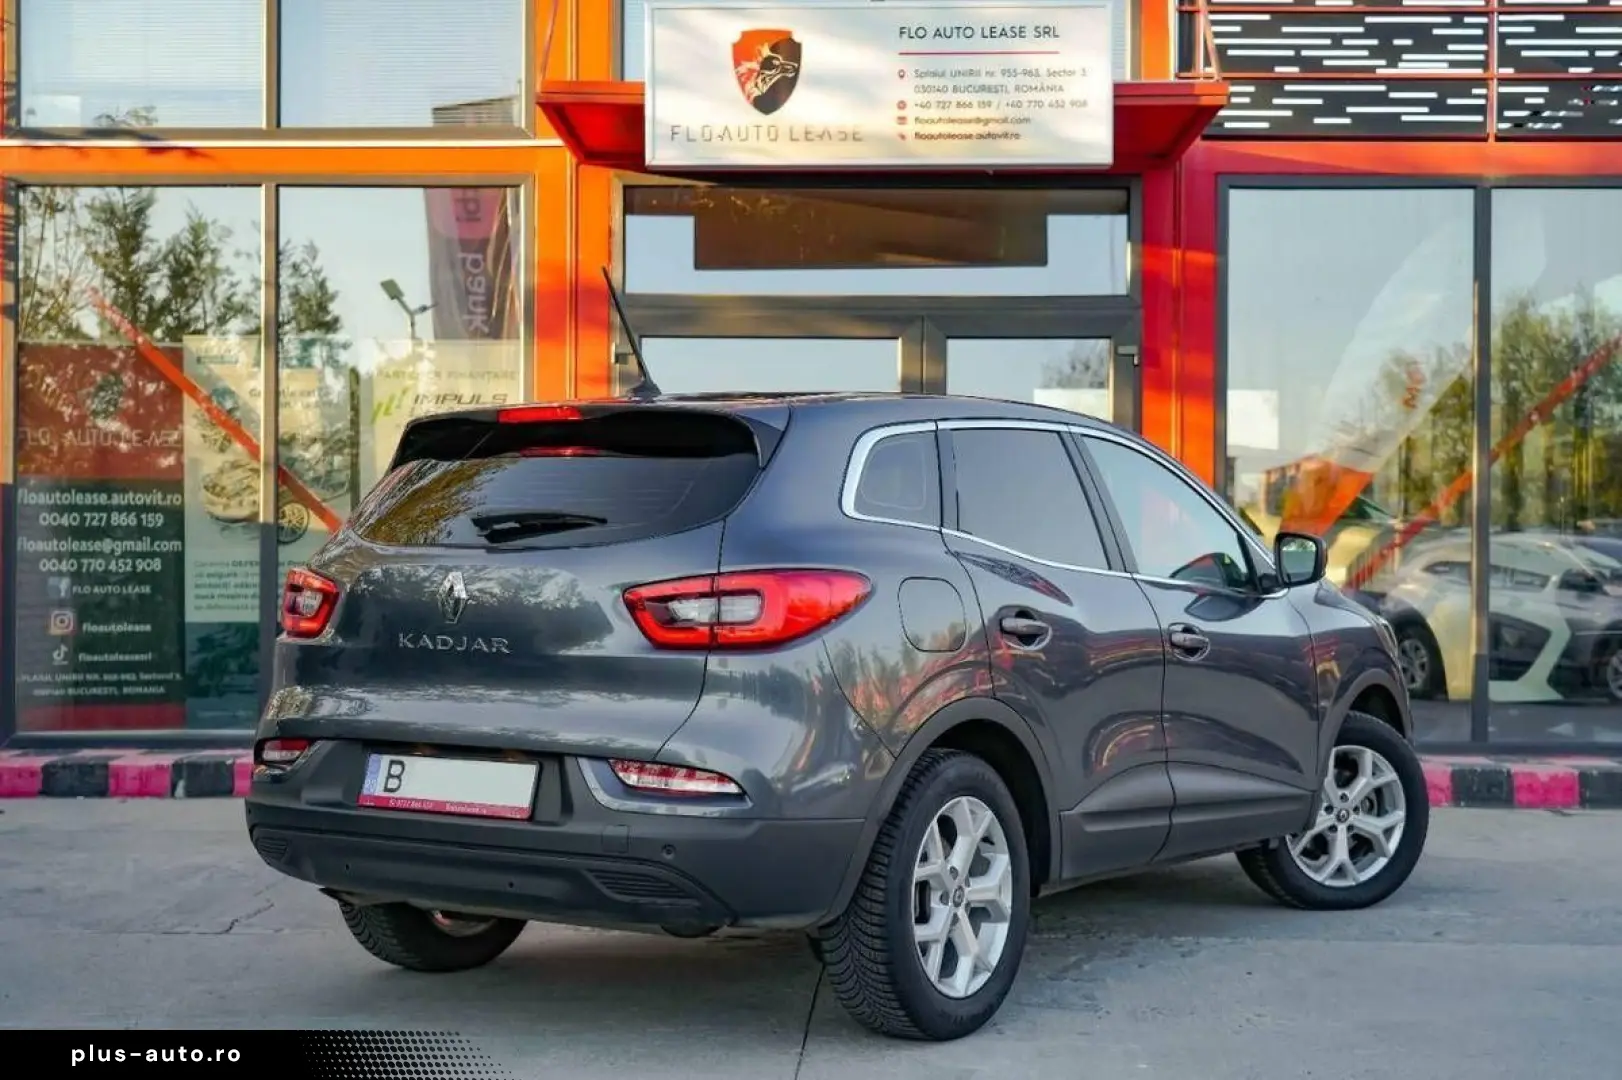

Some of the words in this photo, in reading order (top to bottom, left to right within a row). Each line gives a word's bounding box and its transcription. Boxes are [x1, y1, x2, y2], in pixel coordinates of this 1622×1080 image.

[899, 26, 927, 39] FLO
[933, 26, 975, 39] AUTO
[981, 26, 1027, 39] LEASE
[1034, 25, 1060, 38] SRL
[1046, 68, 1076, 78] Sector
[936, 100, 952, 109] 727
[956, 100, 974, 109] 866
[1027, 100, 1044, 109] 770
[670, 125, 713, 142] FLO
[717, 125, 780, 142] AUTO
[414, 393, 509, 406] IMPULS
[17, 489, 182, 506] floautolease.autovit.ro
[39, 512, 80, 526] 0040
[84, 512, 107, 527] 727
[110, 512, 137, 526] 866
[140, 512, 164, 527] 159
[17, 537, 182, 556] floautolease@gmail.com
[39, 558, 78, 572] 0040
[81, 558, 106, 572] 770
[108, 558, 133, 573] 452
[136, 558, 162, 572] 908
[72, 585, 91, 594] FLO
[93, 585, 121, 594] AUTO
[123, 585, 151, 594] LEASE
[82, 622, 152, 633] floautolease
[399, 632, 511, 654] KADJAR
[383, 759, 406, 793] B
